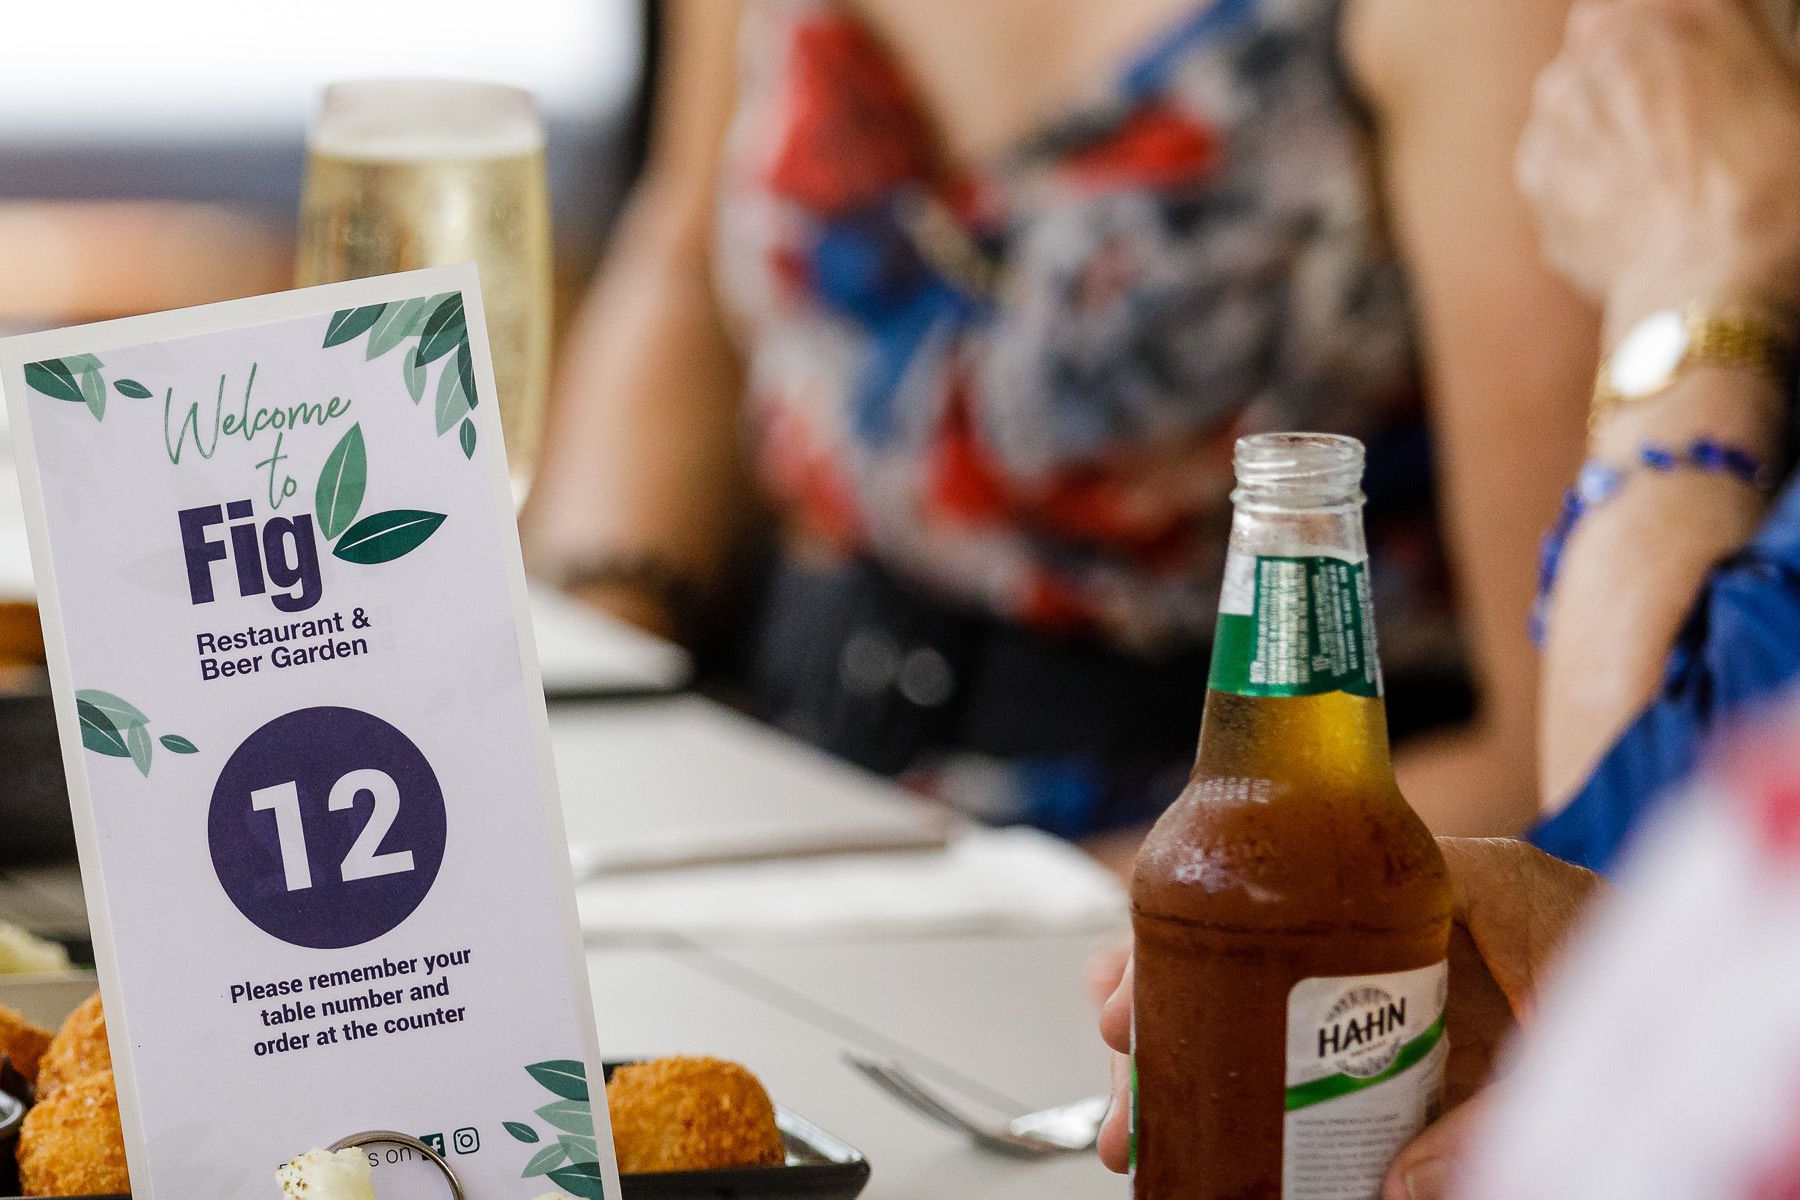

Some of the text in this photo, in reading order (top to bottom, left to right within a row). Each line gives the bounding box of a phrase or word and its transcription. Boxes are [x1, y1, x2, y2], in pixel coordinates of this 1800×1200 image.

[164, 362, 352, 465] Welcome
[255, 433, 298, 511] to
[178, 499, 323, 613] Fig
[196, 607, 372, 656] Restaurant &
[200, 637, 369, 681] Beer Garden
[250, 768, 415, 892] 12
[230, 948, 471, 1004] Please remember your
[260, 975, 450, 1027] table number and
[253, 1006, 466, 1057] order at the counter
[1317, 996, 1407, 1058] HAHN
[385, 1146, 412, 1164] on
